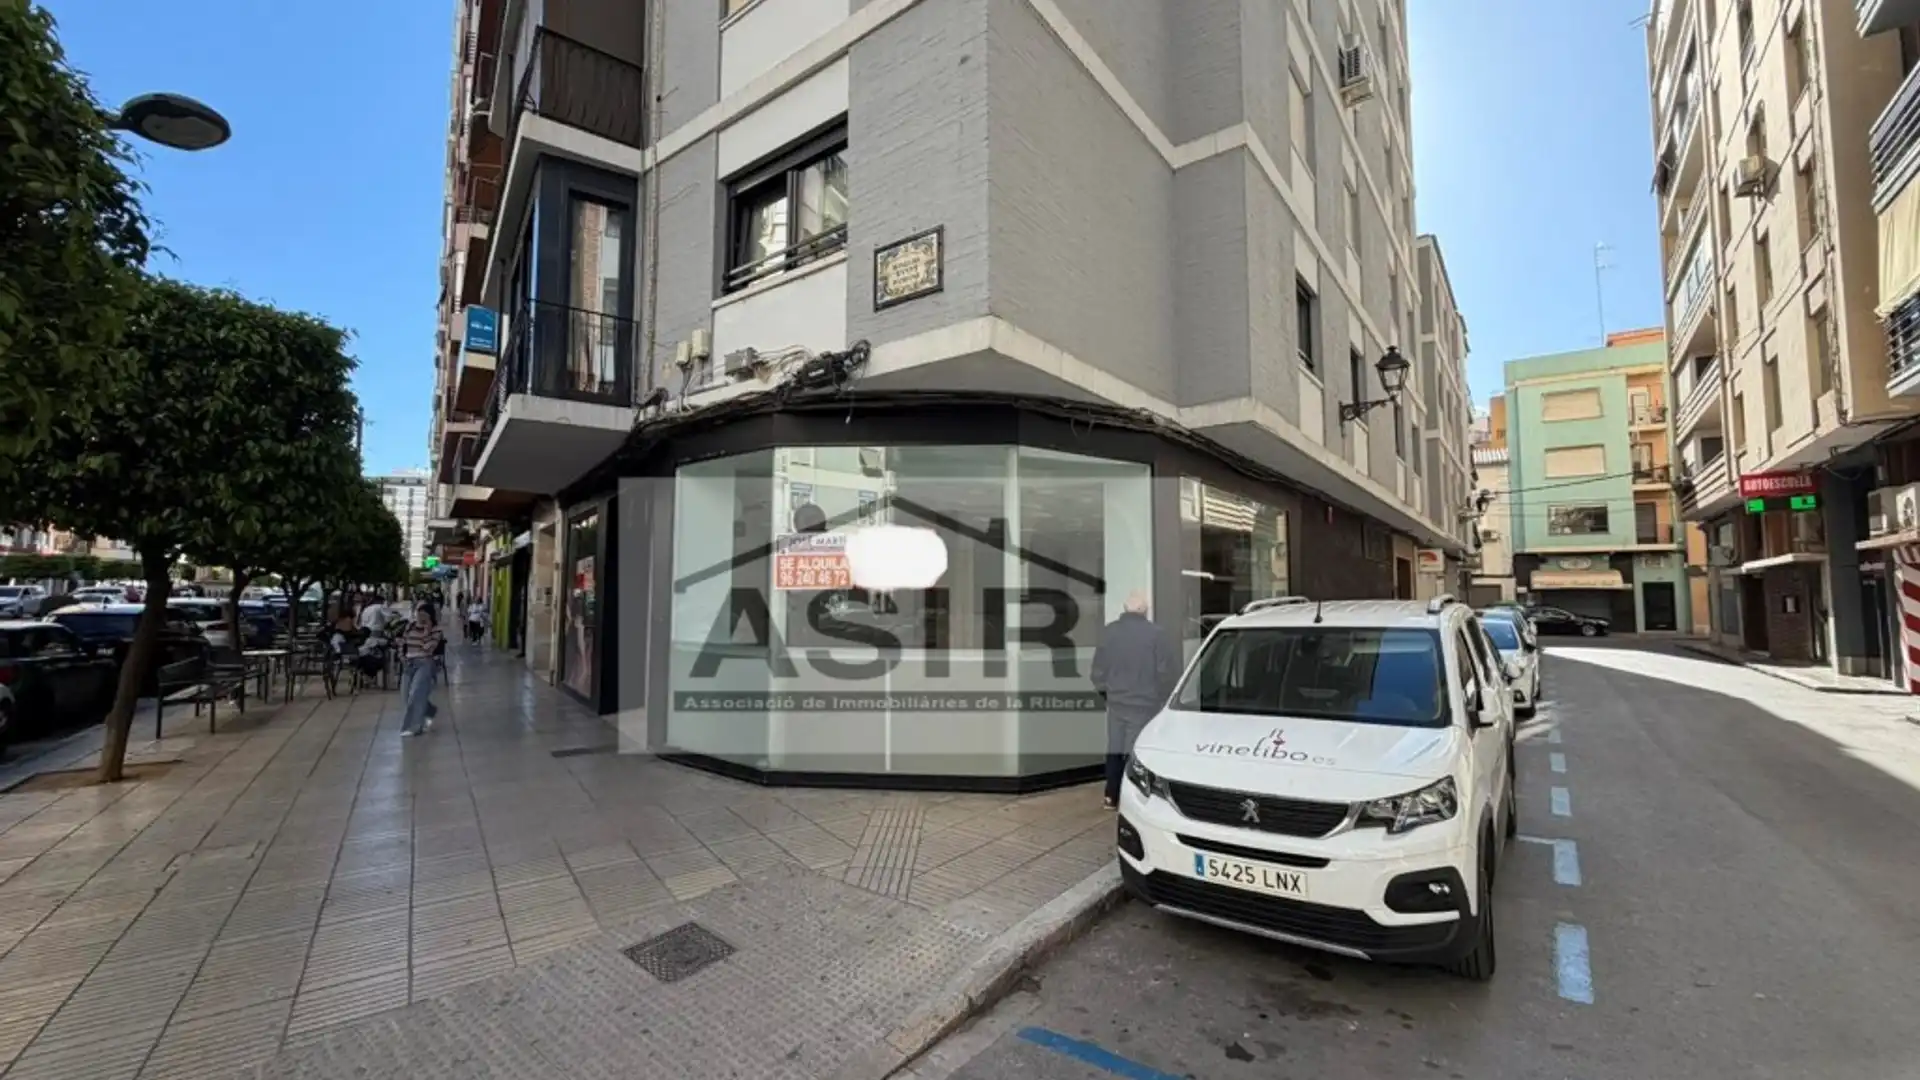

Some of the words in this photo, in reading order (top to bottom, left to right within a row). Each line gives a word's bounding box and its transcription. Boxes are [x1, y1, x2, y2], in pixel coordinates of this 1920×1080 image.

[779, 556, 795, 570] SE
[797, 556, 851, 570] ALQUILA
[1208, 859, 1257, 885] 5425
[1262, 868, 1302, 894] LNX
